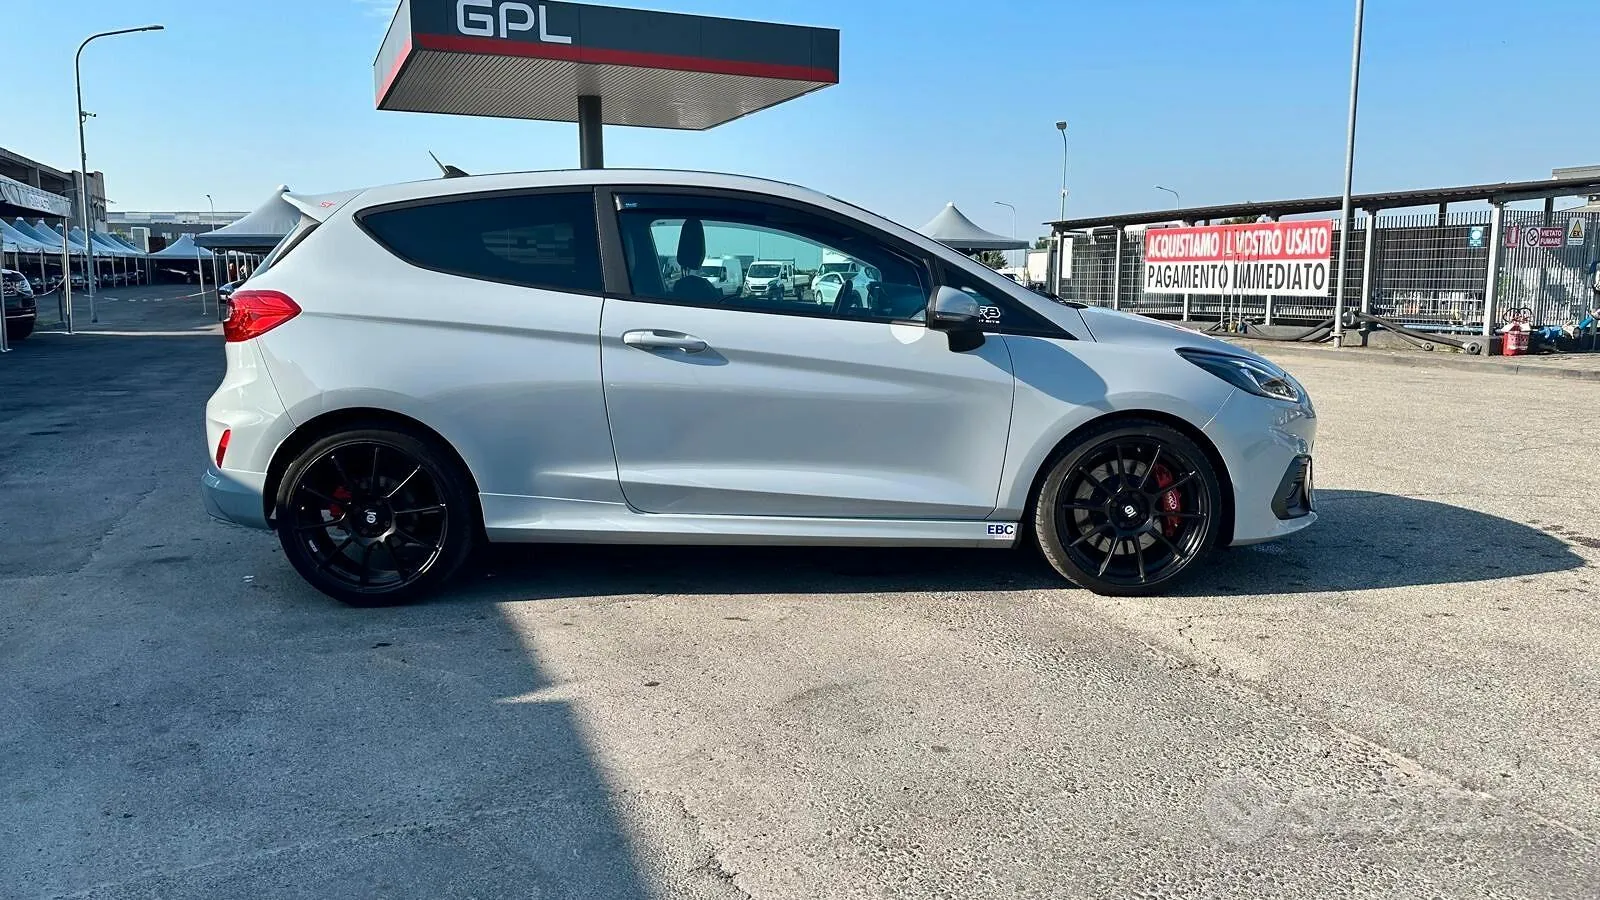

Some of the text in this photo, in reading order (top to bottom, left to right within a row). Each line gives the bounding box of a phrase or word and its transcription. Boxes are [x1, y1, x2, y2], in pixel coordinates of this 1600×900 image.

[456, 0, 572, 44] GPL
[1148, 231, 1220, 258] ACQUISTIAMO
[1234, 229, 1282, 257] VOSTRO
[1285, 227, 1328, 255] USATO
[1541, 229, 1562, 237] VIETATO
[1148, 262, 1325, 290] PAGAMENTO IMMEDIATO
[987, 524, 1014, 535] EBC
